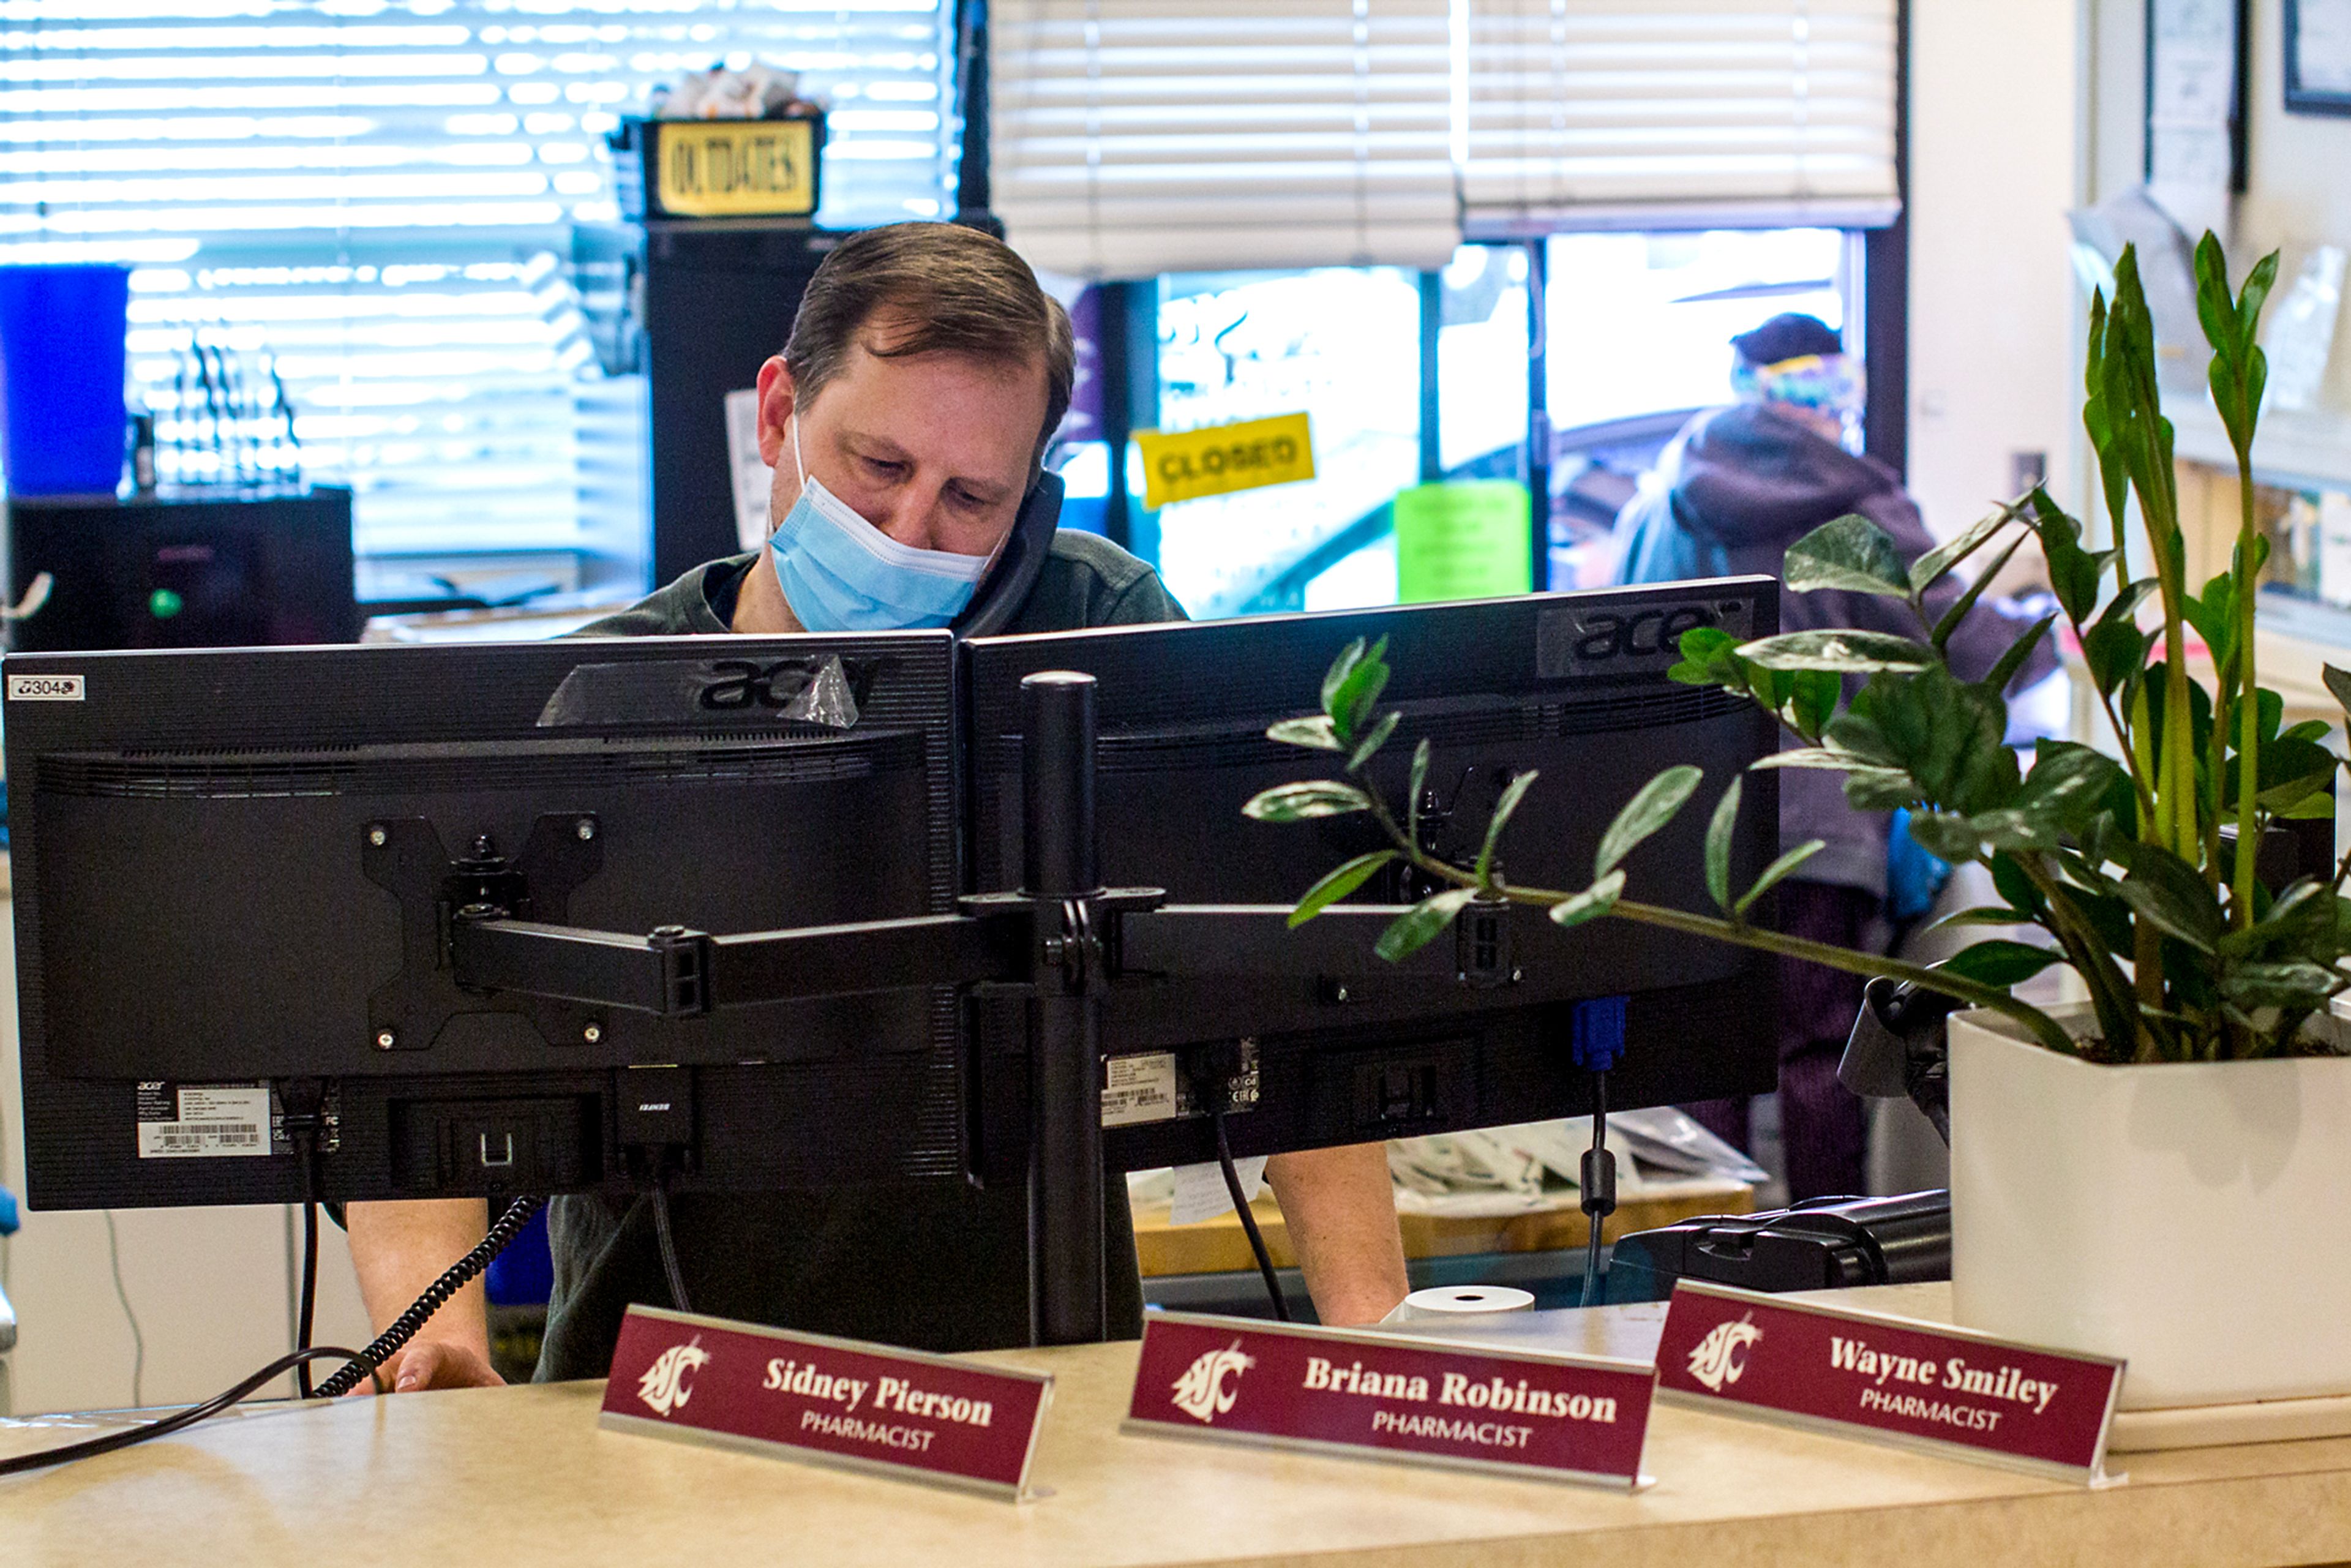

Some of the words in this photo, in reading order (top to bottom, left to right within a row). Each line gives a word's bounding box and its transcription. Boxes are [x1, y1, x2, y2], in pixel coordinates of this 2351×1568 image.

[1158, 435, 1297, 484] CLOSED
[763, 1358, 868, 1412] Sidney
[874, 1376, 992, 1427] Pierson
[1303, 1357, 1428, 1401] Briana
[1439, 1373, 1617, 1423] Robinson
[1830, 1337, 1936, 1386] Wayne
[1942, 1357, 2058, 1415] Smiley
[801, 1410, 934, 1452] PHARMACIST
[1372, 1411, 1533, 1448] PHARMACIST
[1860, 1389, 2001, 1431] PHARMACIST
